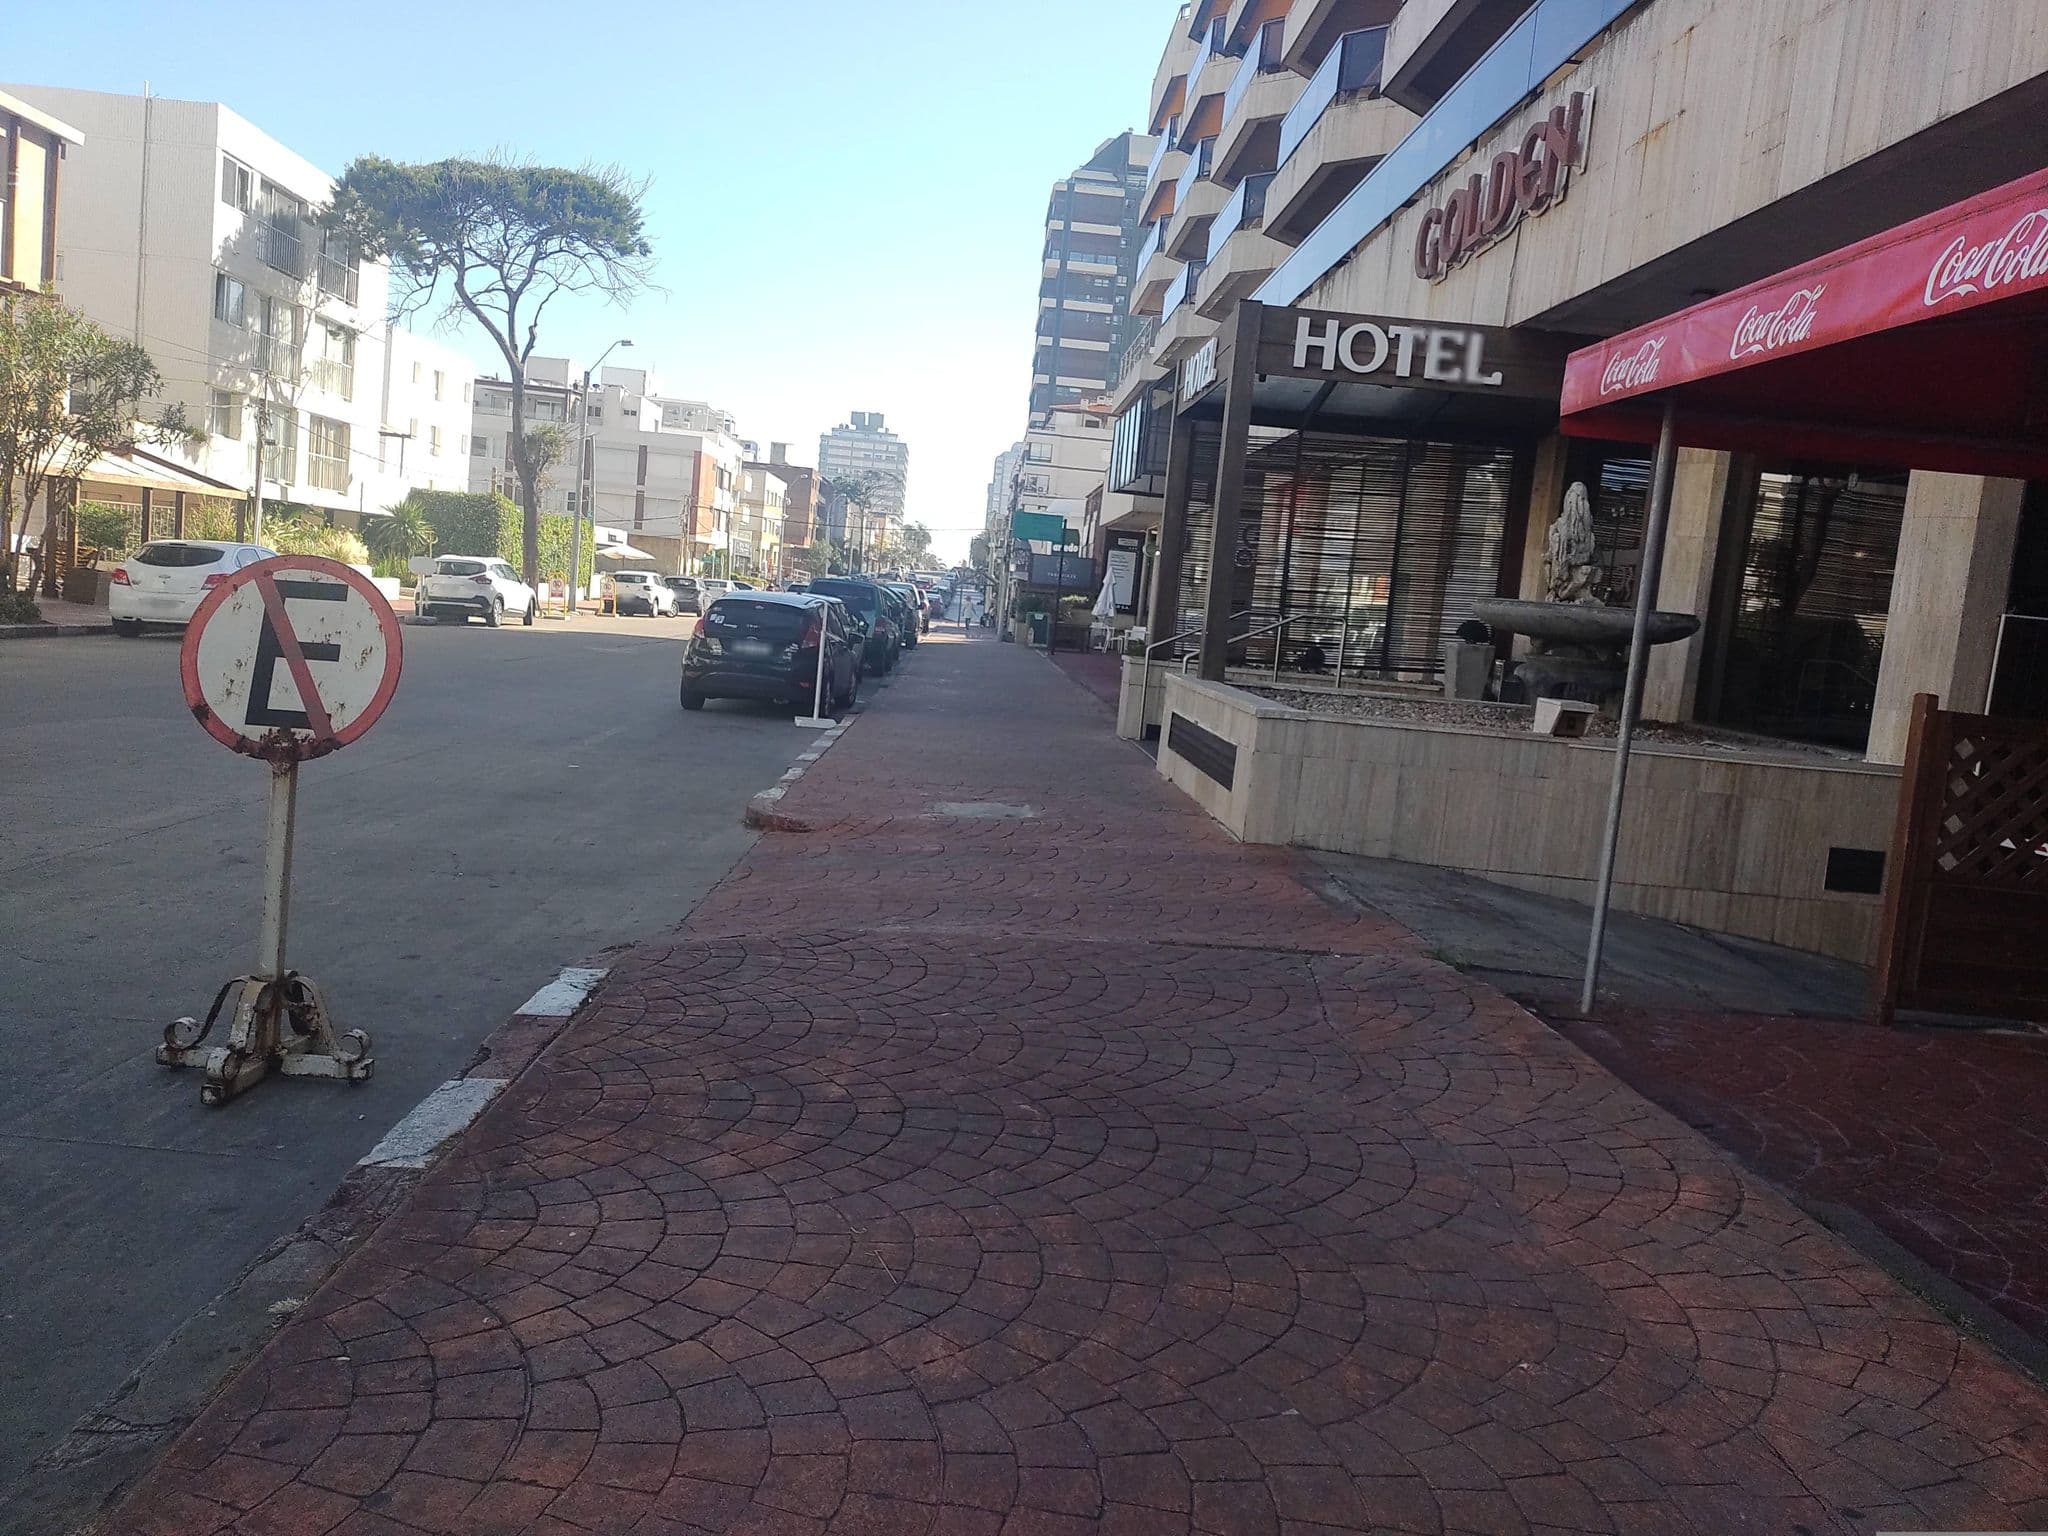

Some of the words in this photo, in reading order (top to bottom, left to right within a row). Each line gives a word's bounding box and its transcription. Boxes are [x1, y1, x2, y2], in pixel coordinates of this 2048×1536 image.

[1415, 91, 1588, 281] GOLDEN
[1293, 316, 1503, 386] HOTEL
[1729, 282, 1828, 360] Coca-Cola
[1183, 336, 1218, 402] HOTEL
[1600, 336, 1667, 395] Coca-Cola
[245, 579, 349, 731] E
